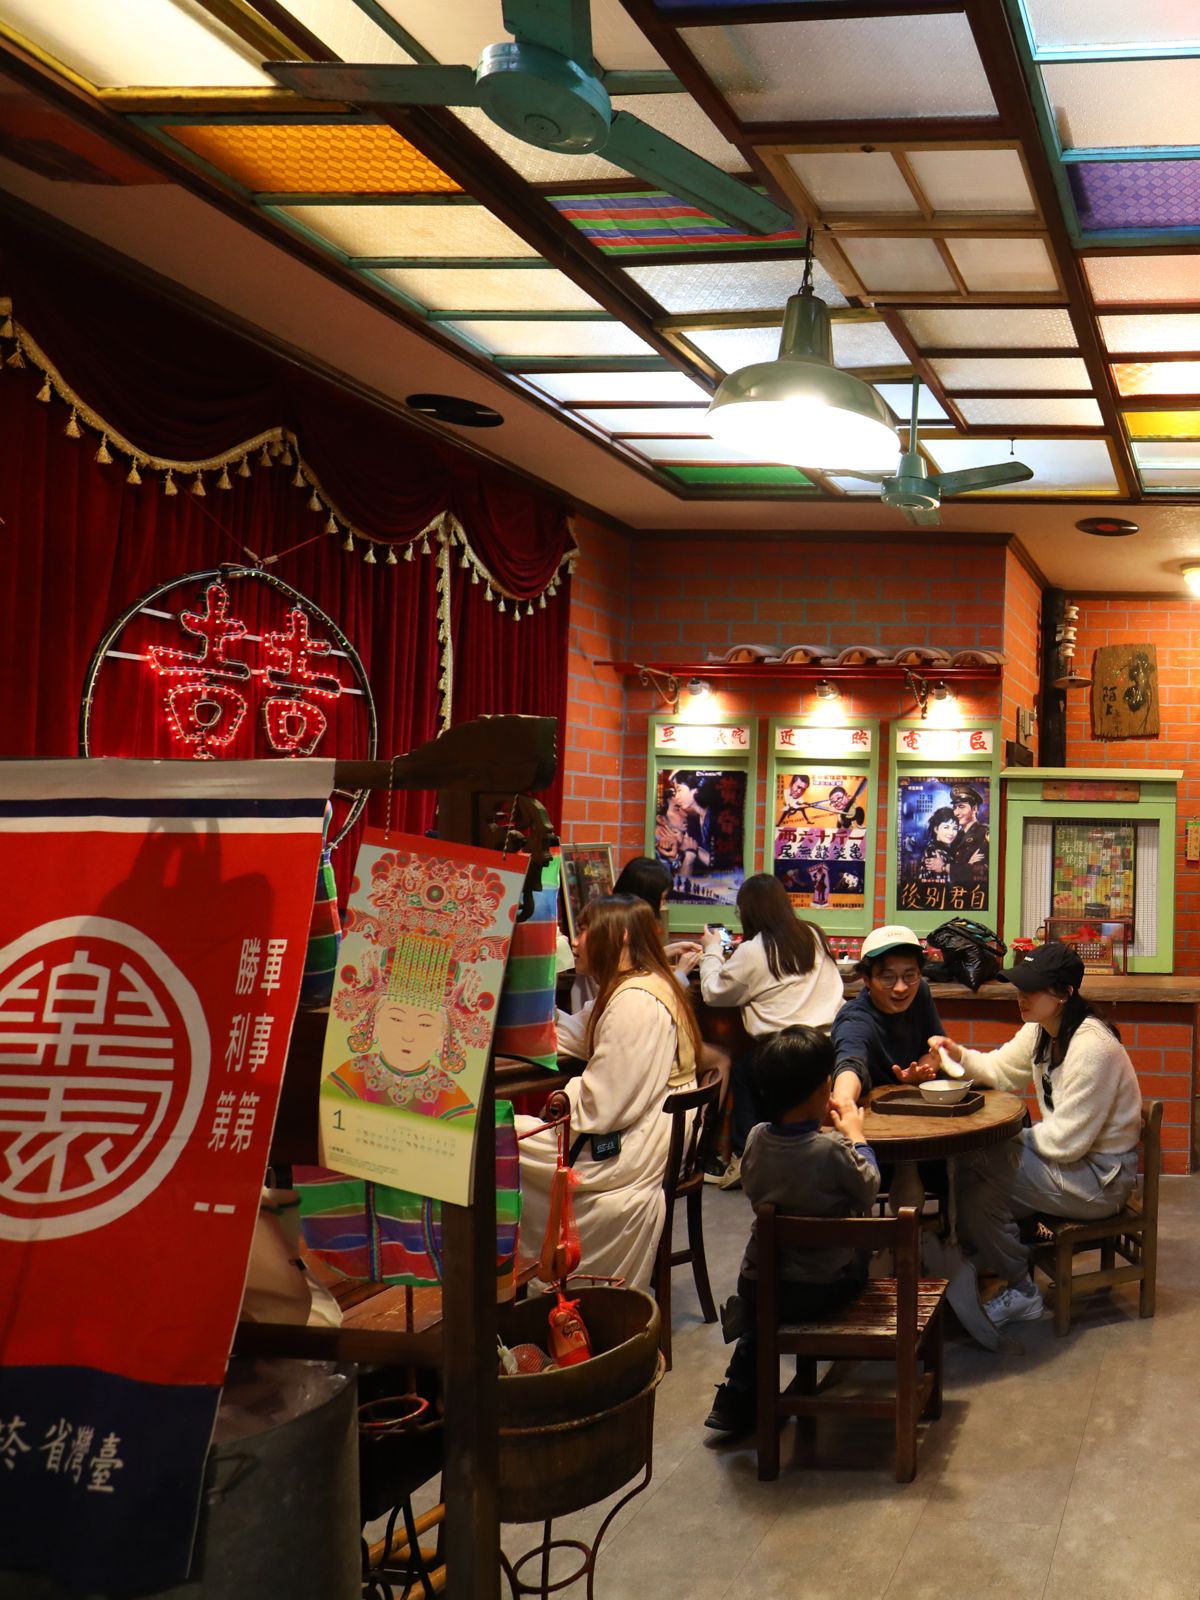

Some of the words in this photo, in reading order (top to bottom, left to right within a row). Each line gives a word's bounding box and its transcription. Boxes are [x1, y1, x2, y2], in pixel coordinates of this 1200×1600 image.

[661, 726, 748, 746] 亞院
[780, 729, 869, 746] 近映
[902, 730, 988, 751] 電區
[901, 882, 986, 910] 自君別後
[193, 936, 262, 1213] 勝利第一
[212, 937, 289, 1215] 軍事第一
[332, 1109, 346, 1131] 1
